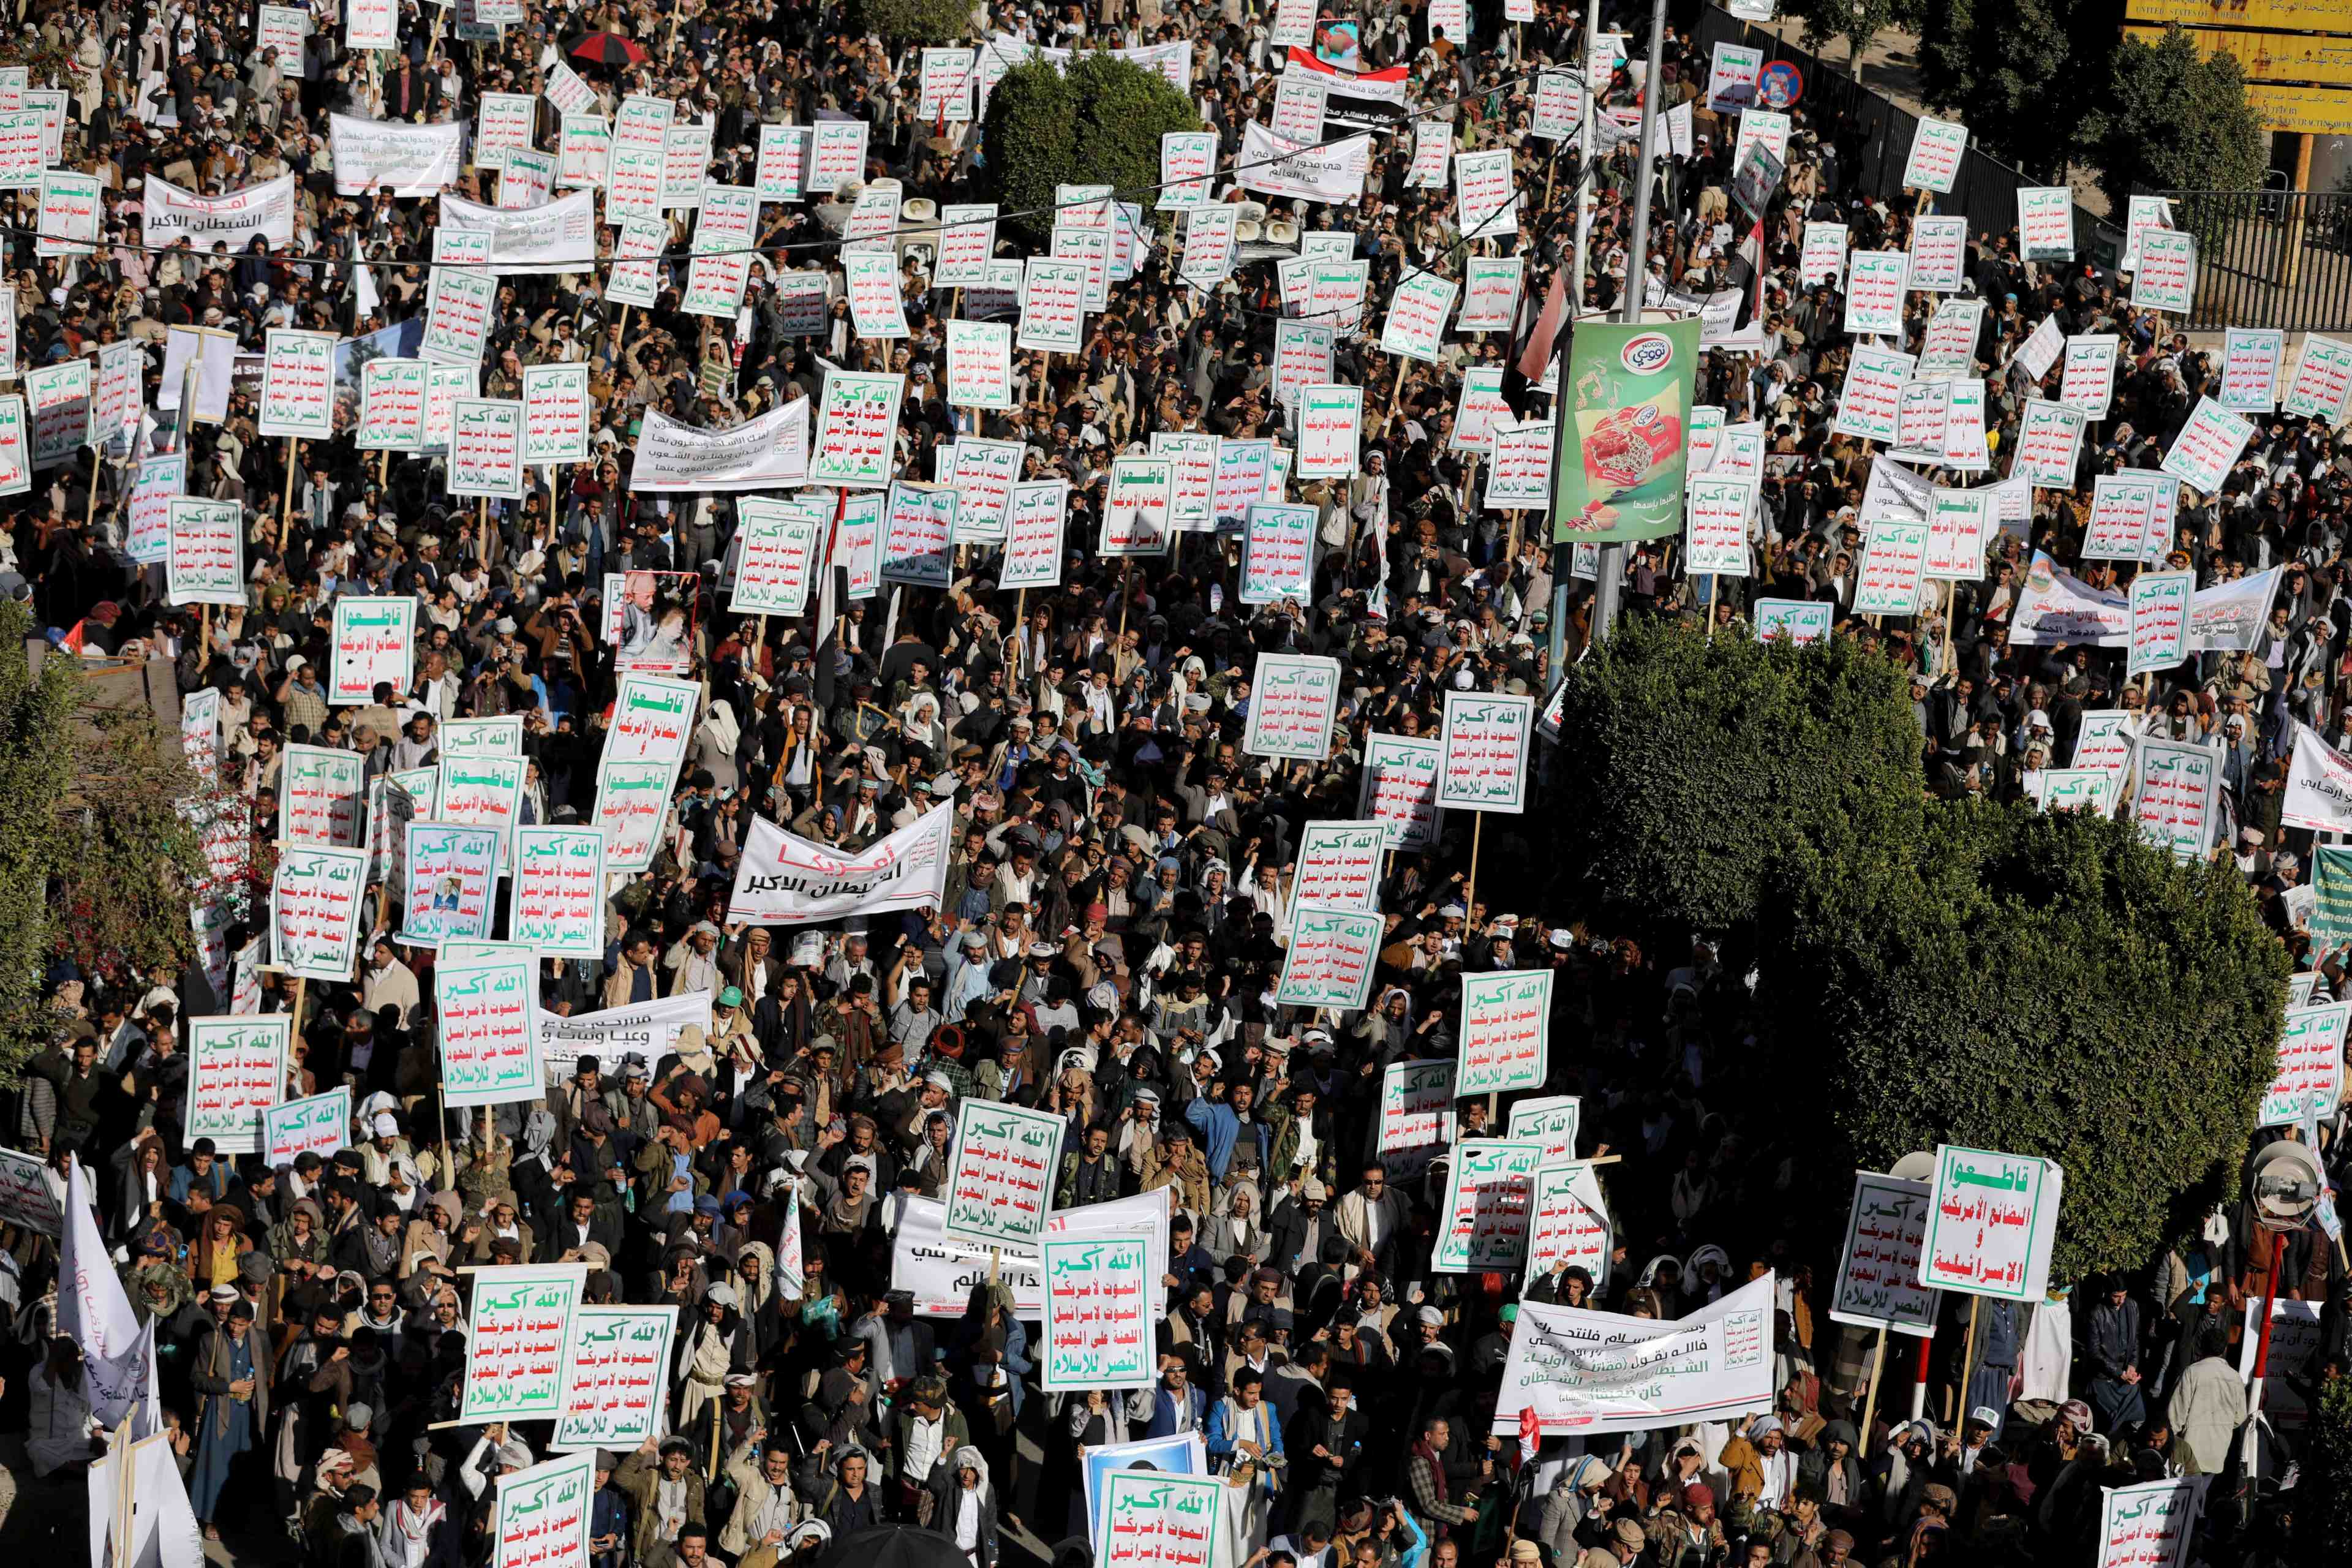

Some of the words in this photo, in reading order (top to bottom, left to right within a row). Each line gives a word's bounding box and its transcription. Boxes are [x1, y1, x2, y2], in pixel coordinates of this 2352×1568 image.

[1269, 168, 1299, 179] العالم
[1303, 175, 1318, 183] هذا
[194, 214, 262, 233] الشيطان
[1118, 466, 1165, 488] قاطعوا
[1141, 492, 1167, 510] البضائع
[1496, 707, 1522, 723] الله
[1490, 731, 1520, 742] الموت
[1488, 749, 1518, 761] الموت
[1449, 764, 1474, 776] اليهود
[1476, 766, 1490, 777] على
[1493, 766, 1516, 775] اللعنة
[1482, 780, 1514, 798] النصر
[2301, 779, 2342, 800] إرهابي
[777, 843, 895, 876] أمريكا
[493, 971, 522, 990] الله
[1517, 981, 1544, 998] الله
[489, 999, 524, 1016] الموت
[1510, 1006, 1541, 1022] الموت
[491, 1020, 526, 1038] الموت
[1509, 1025, 1539, 1041] الموت
[448, 1046, 477, 1062] اليهود
[481, 1046, 496, 1060] على
[501, 1042, 527, 1055] اللعنة
[1497, 1049, 1510, 1063] على
[1515, 1044, 1537, 1057] اللعنة
[1468, 1050, 1493, 1066] اليهود
[492, 1061, 529, 1085] النصر
[1503, 1061, 1536, 1084] النصر
[1020, 1125, 1052, 1147] الله
[1011, 1153, 1048, 1169] الموت
[1008, 1175, 1044, 1190] الموت
[1948, 1156, 2029, 1192] قاطعوا
[957, 1186, 988, 1202] اليهود
[991, 1193, 1008, 1206] على
[1012, 1196, 1040, 1212] اللعنة
[1940, 1193, 1988, 1222] الأمريكية
[1989, 1201, 2030, 1230] البضائع
[997, 1215, 1036, 1234] النصر
[1975, 1227, 1983, 1248] و
[1107, 1248, 1140, 1268] الله
[1933, 1250, 2023, 1287] الإسرائيلية
[534, 1286, 567, 1306] الله
[1102, 1280, 1140, 1297] الموت
[1103, 1304, 1141, 1322] الموت
[526, 1316, 564, 1333] الموت
[1054, 1331, 1086, 1348] اليهود
[1091, 1331, 1107, 1348] على
[1113, 1329, 1142, 1343] اللعنة
[523, 1338, 560, 1355] الموت
[508, 1363, 524, 1379] على
[529, 1362, 558, 1374] اللعنة
[1102, 1350, 1143, 1376] النصر
[473, 1364, 504, 1381] اليهود
[514, 1381, 555, 1406] النصر
